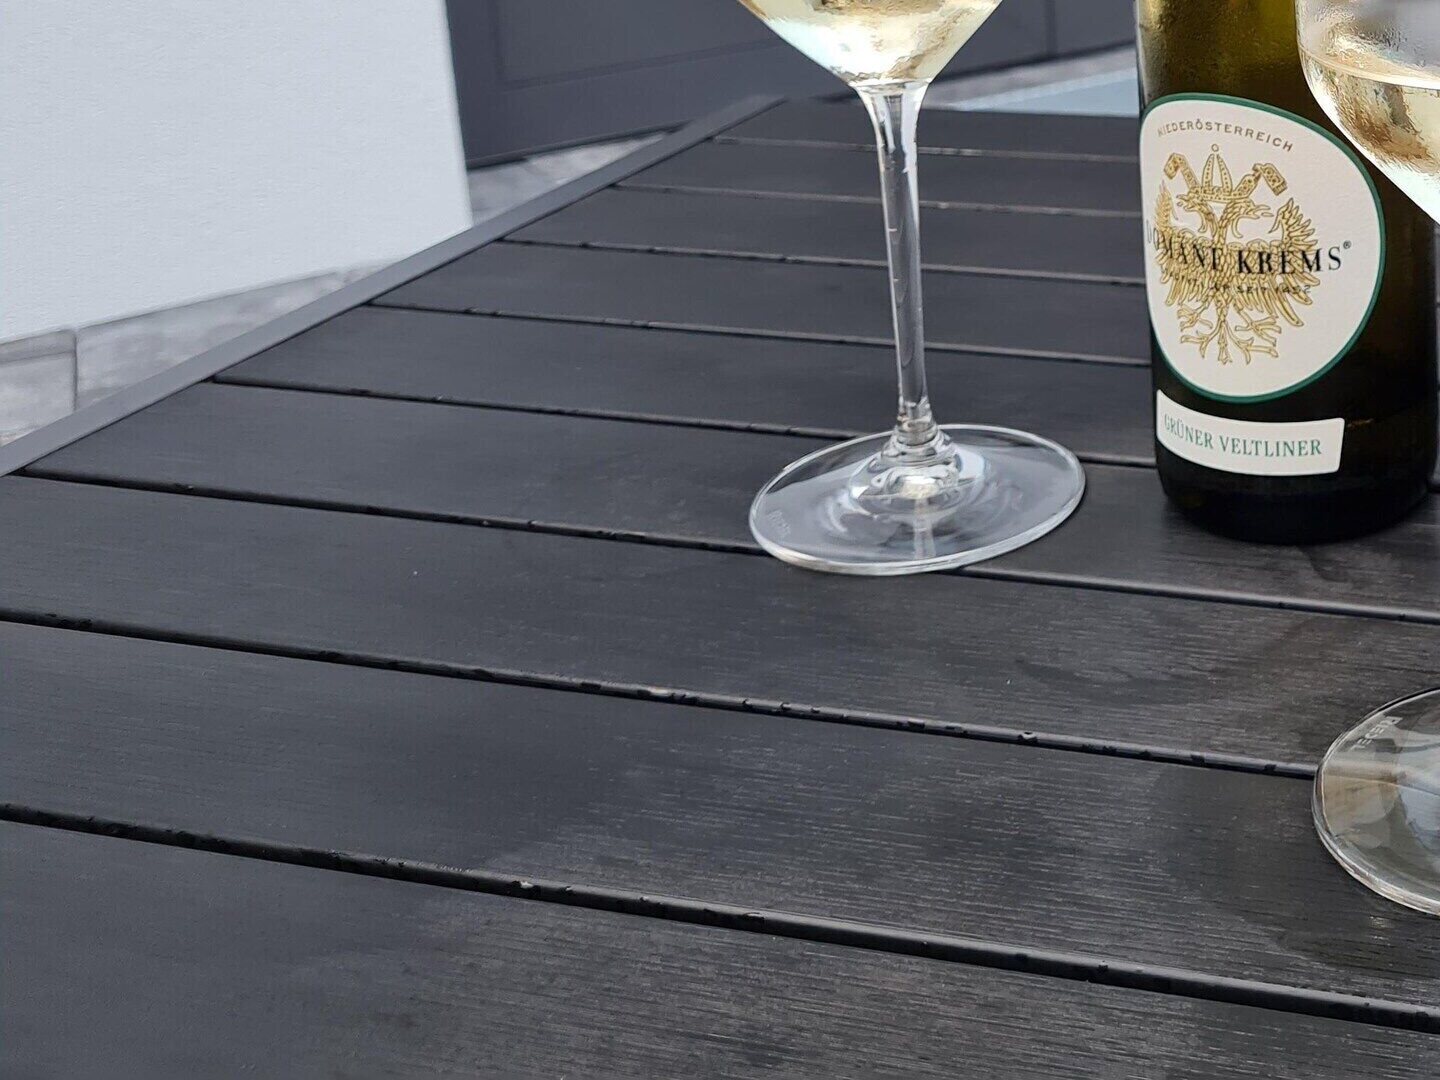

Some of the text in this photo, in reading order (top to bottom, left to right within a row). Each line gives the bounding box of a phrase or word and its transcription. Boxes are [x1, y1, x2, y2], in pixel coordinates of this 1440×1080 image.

[1157, 118, 1294, 153] NIEDERÖSTERREICH
[1164, 413, 1322, 458] GRÜNER VELTLINER
